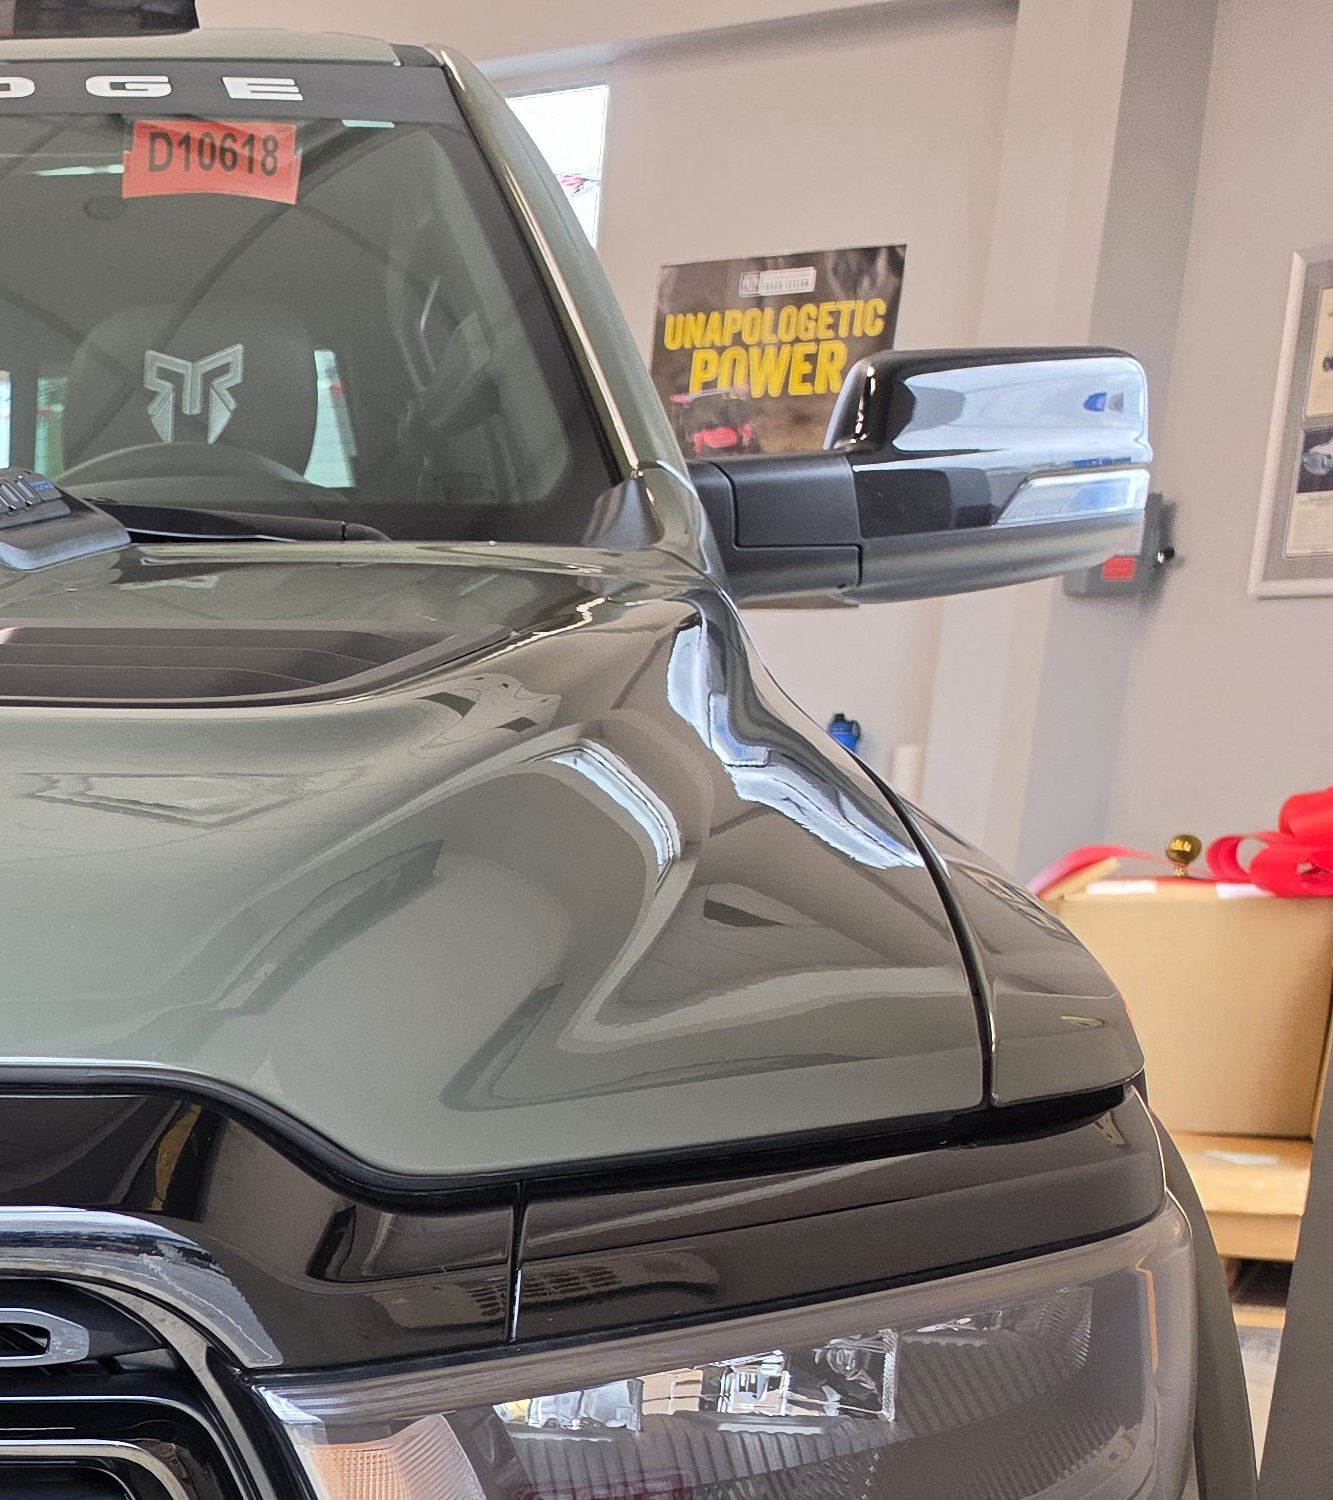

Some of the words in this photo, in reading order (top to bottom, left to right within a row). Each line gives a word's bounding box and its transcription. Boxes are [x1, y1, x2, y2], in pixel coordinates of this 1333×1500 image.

[148, 131, 280, 177] D10618
[664, 298, 887, 350] UNAPOLOGETIC
[689, 340, 849, 398] POWER
